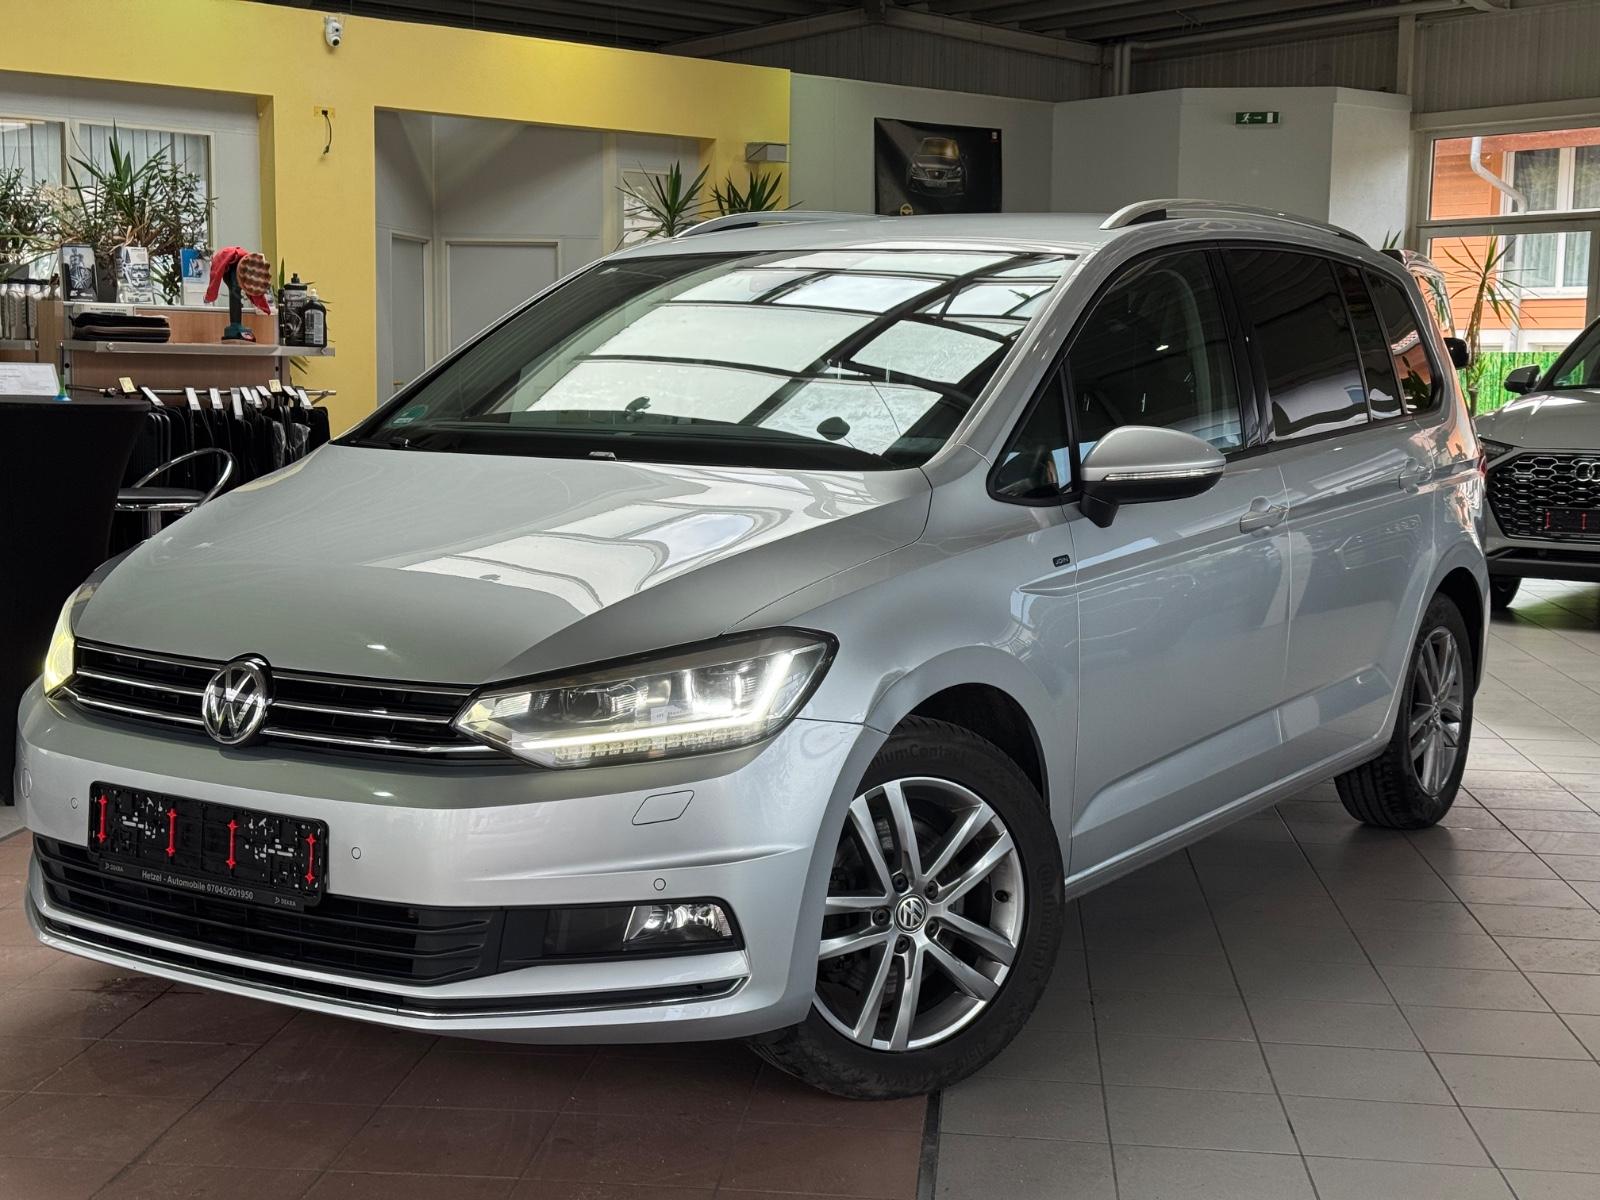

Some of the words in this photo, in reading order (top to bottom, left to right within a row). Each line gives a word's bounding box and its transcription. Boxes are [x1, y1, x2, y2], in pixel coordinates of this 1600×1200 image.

[142, 869, 162, 882] Hetzel
[167, 875, 206, 891] Automobile
[207, 884, 253, 900] 07045/201950
